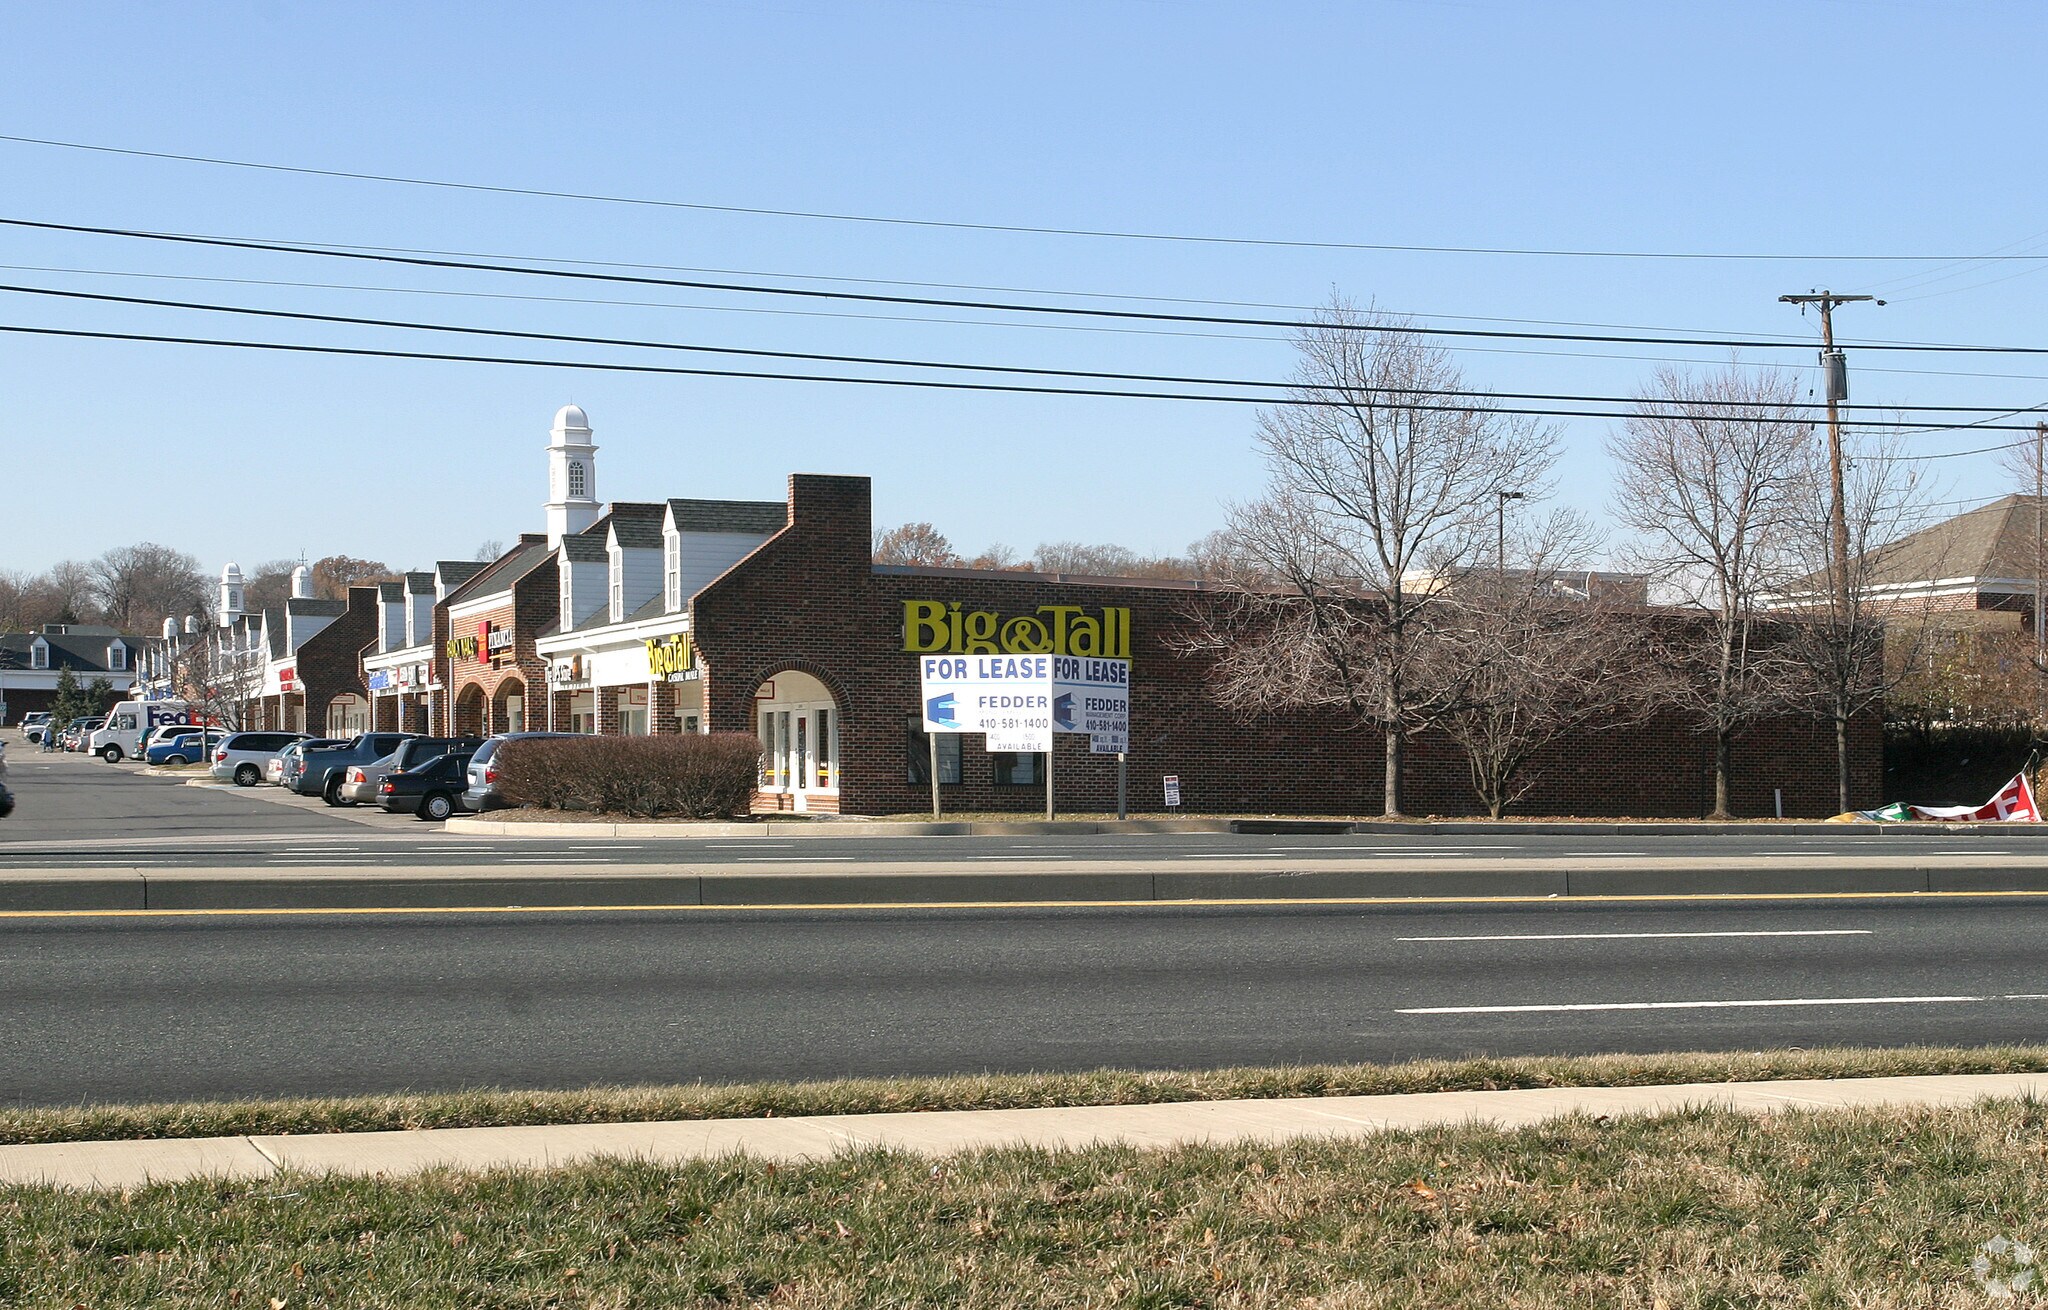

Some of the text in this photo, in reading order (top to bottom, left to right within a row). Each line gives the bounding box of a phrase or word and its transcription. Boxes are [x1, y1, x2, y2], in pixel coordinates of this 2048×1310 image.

[926, 659, 1047, 679] FOR LEASE
[1054, 658, 1127, 683] FOR LEASE
[979, 696, 1048, 708] FEDDER
[1085, 698, 1127, 712] FEDDER
[980, 718, 1049, 729] 410-581-1400
[997, 742, 1042, 751] AVAILABLE
[1096, 744, 1123, 753] AVAILABLE
